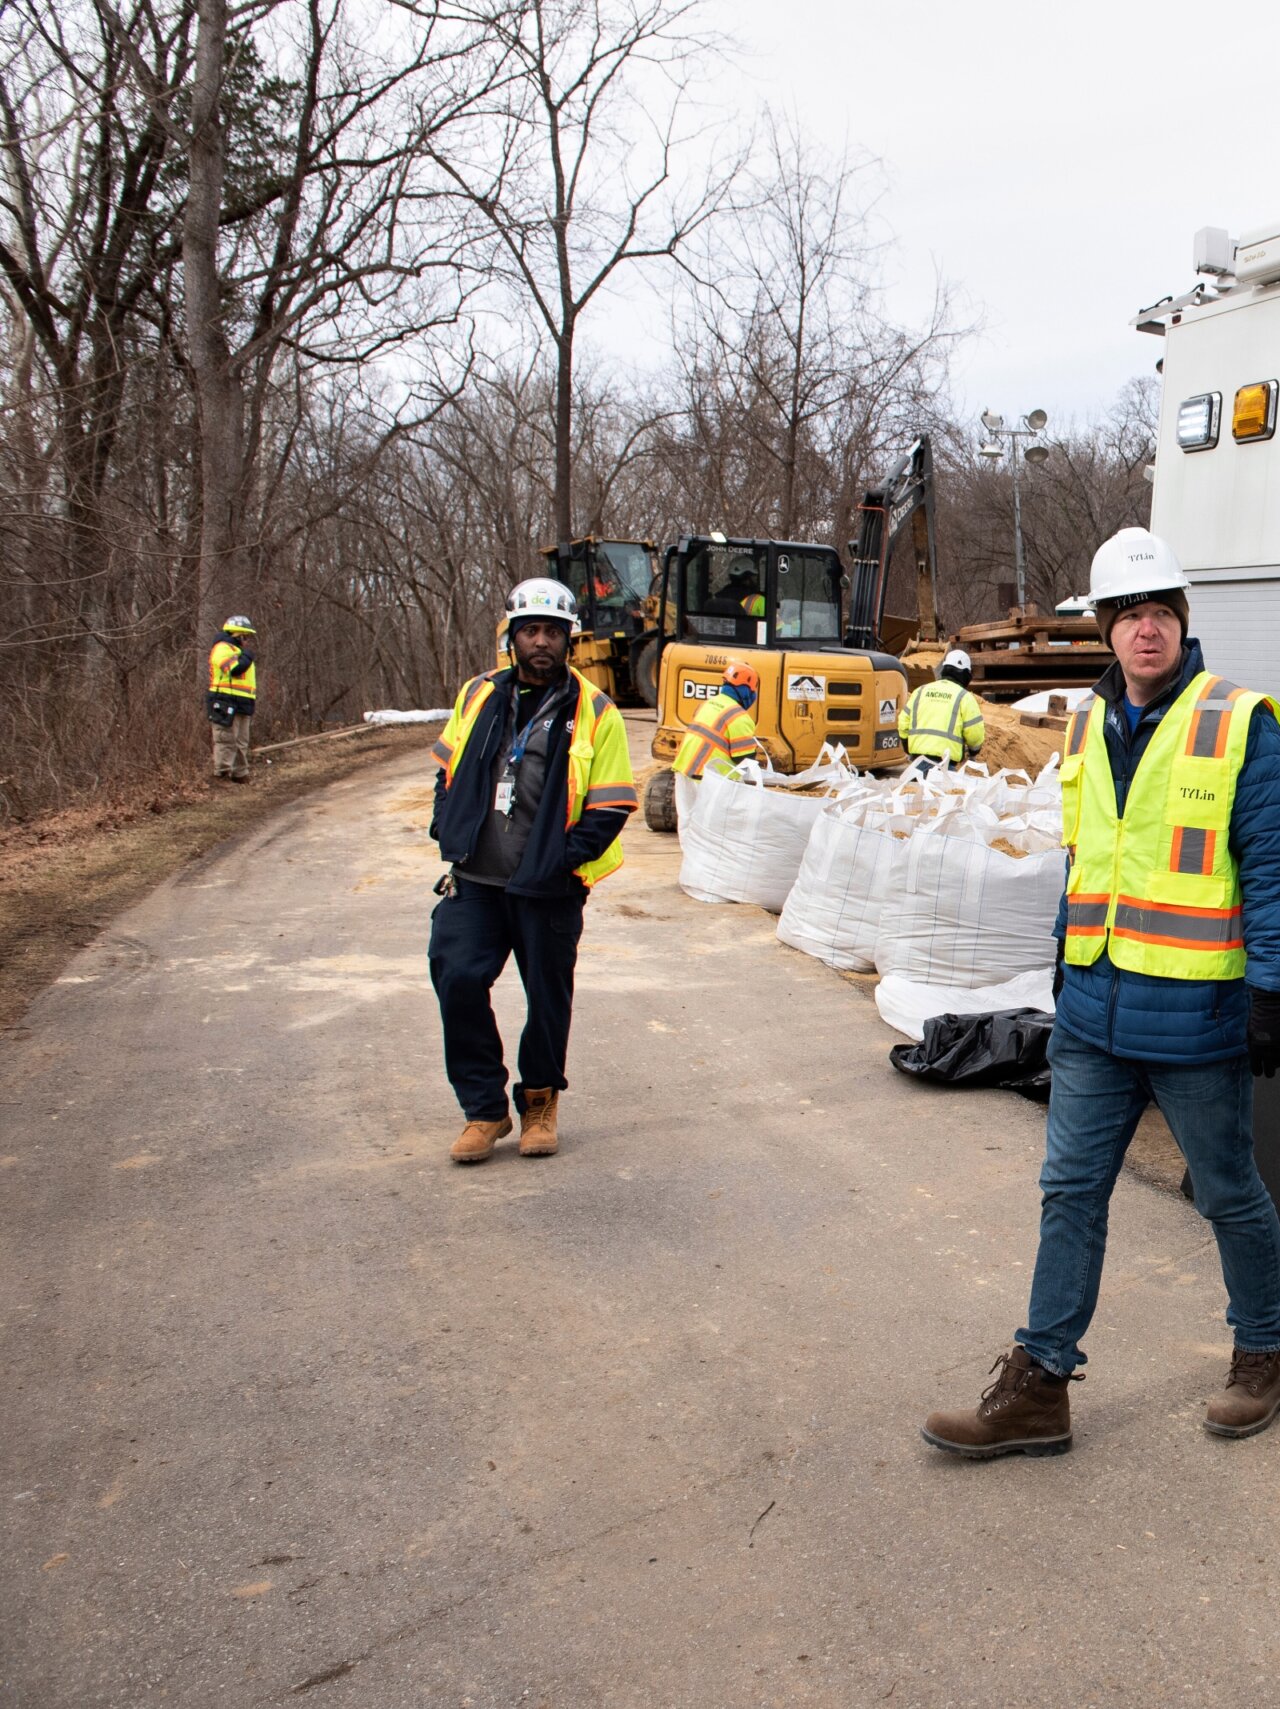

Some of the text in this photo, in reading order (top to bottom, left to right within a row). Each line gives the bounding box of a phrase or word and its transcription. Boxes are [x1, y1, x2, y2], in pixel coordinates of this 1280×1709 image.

[706, 545, 754, 555] JOHN DEERE
[1128, 553, 1154, 562] TYLin
[683, 679, 723, 700] DEE
[925, 691, 952, 700] ANCHOR
[1180, 787, 1215, 801] TYLin
